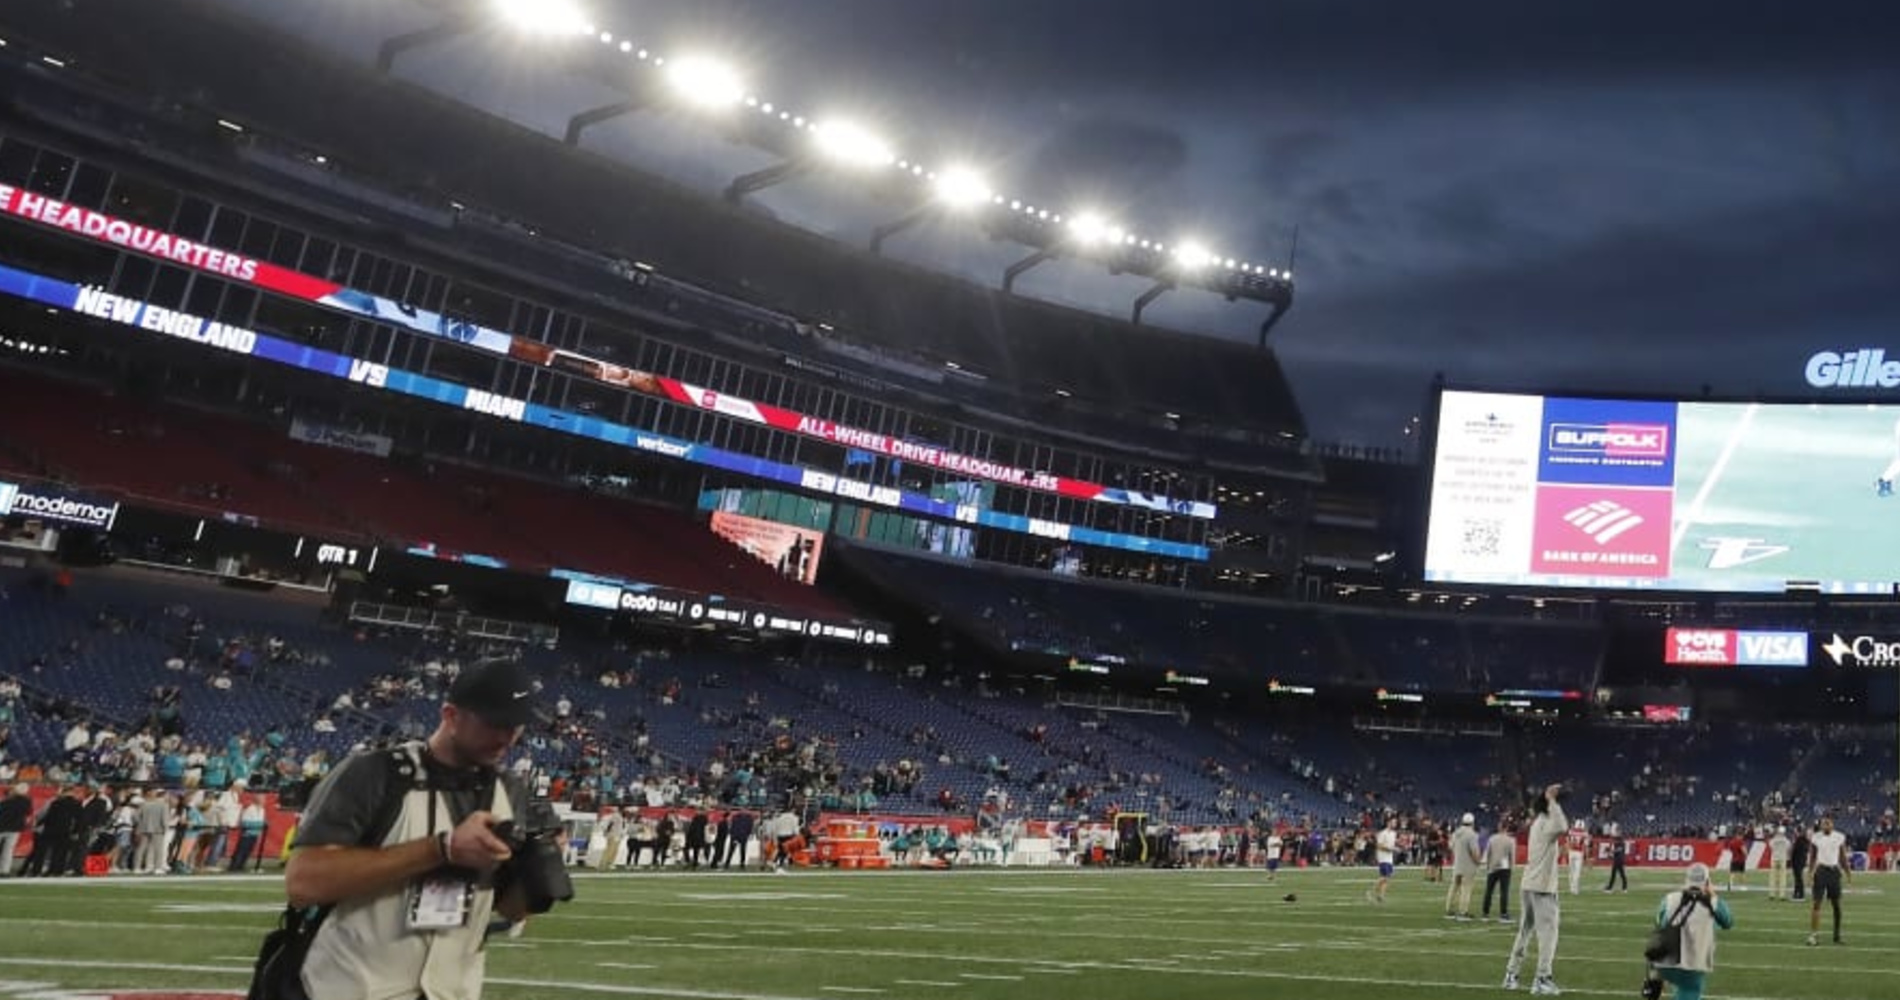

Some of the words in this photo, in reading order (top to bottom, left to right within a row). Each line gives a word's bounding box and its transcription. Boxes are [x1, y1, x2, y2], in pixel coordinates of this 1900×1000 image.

[17, 192, 259, 281] HEADQUARTERS
[74, 285, 145, 325] NEW
[140, 302, 257, 354] ENGLAND
[349, 359, 389, 387] VS
[464, 387, 526, 420] MIAMI
[797, 417, 889, 453] ALL-WHEEL
[891, 440, 939, 465] DRIVE
[1556, 431, 1659, 447] SUFFOLK
[800, 469, 838, 492] NEW
[836, 477, 901, 507] ENGLAND
[13, 490, 113, 520] moderna
[954, 504, 979, 523] VS
[317, 544, 345, 563] QTR
[1543, 550, 1580, 562] BANK
[1580, 551, 1599, 563] OF
[1598, 553, 1658, 565] AMERICA
[621, 593, 658, 612] 0:00
[1693, 633, 1727, 647] CVS
[1742, 635, 1803, 660] VISA
[1678, 646, 1727, 662] Health
[1598, 841, 1642, 860] ET.
[1648, 844, 1694, 861] 1960
